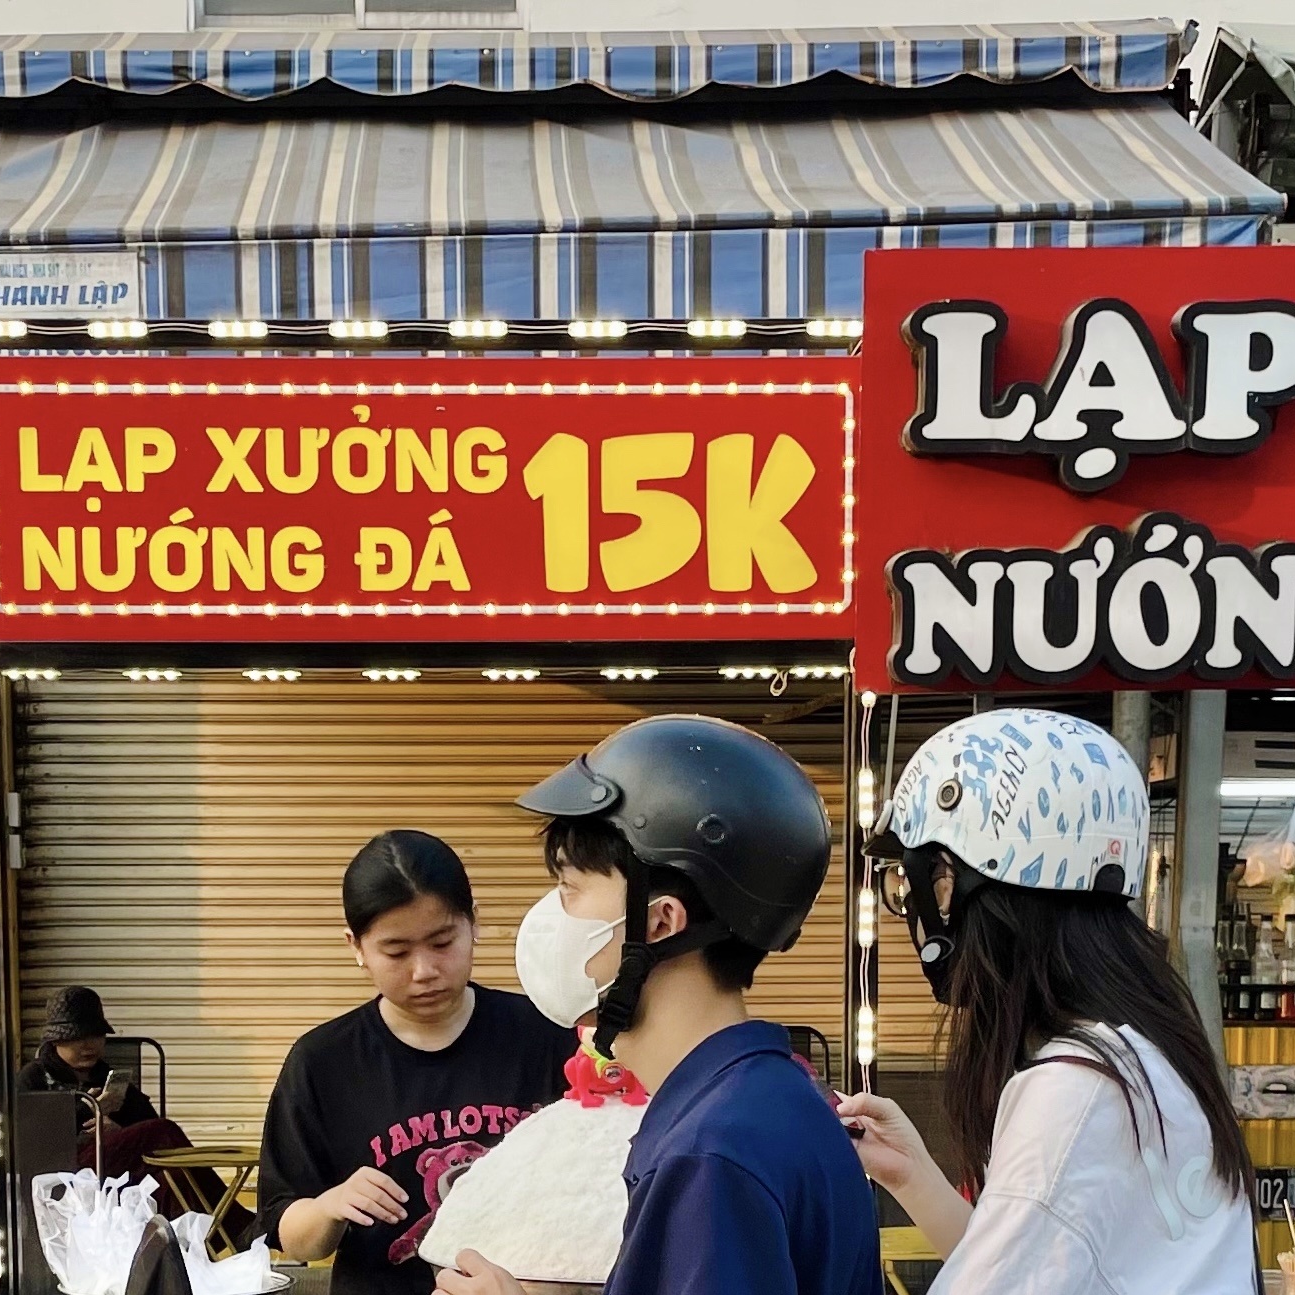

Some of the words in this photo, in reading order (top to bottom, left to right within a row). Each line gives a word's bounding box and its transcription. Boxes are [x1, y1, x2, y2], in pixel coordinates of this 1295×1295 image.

[18, 426, 177, 514] LẠP
[205, 403, 509, 495] XƯỞNG
[21, 507, 326, 593] NƯỚNG
[354, 508, 472, 593] ĐÁ
[523, 431, 819, 594] 15K
[369, 1135, 387, 1168] I
[388, 1112, 439, 1157] AM
[440, 1103, 533, 1139] LOTS
